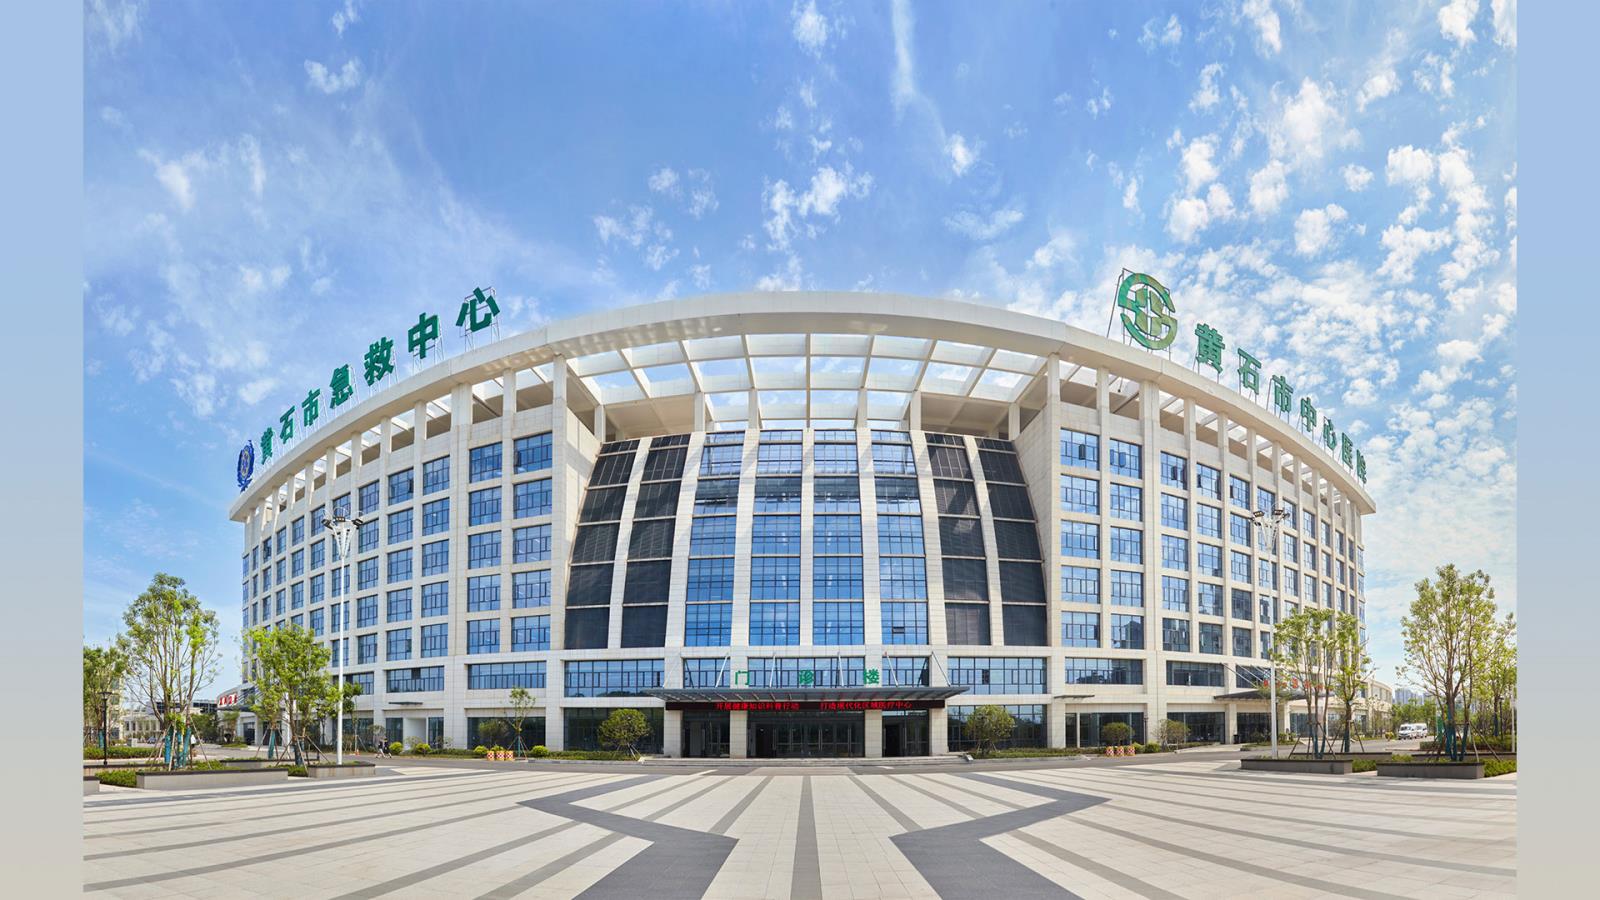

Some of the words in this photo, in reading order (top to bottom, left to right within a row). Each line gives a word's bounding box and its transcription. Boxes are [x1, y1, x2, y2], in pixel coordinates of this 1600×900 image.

[260, 286, 500, 465] 黄石市急救中心
[1194, 322, 1367, 484] 黄石市中心医院
[734, 669, 880, 686] 门诊楼
